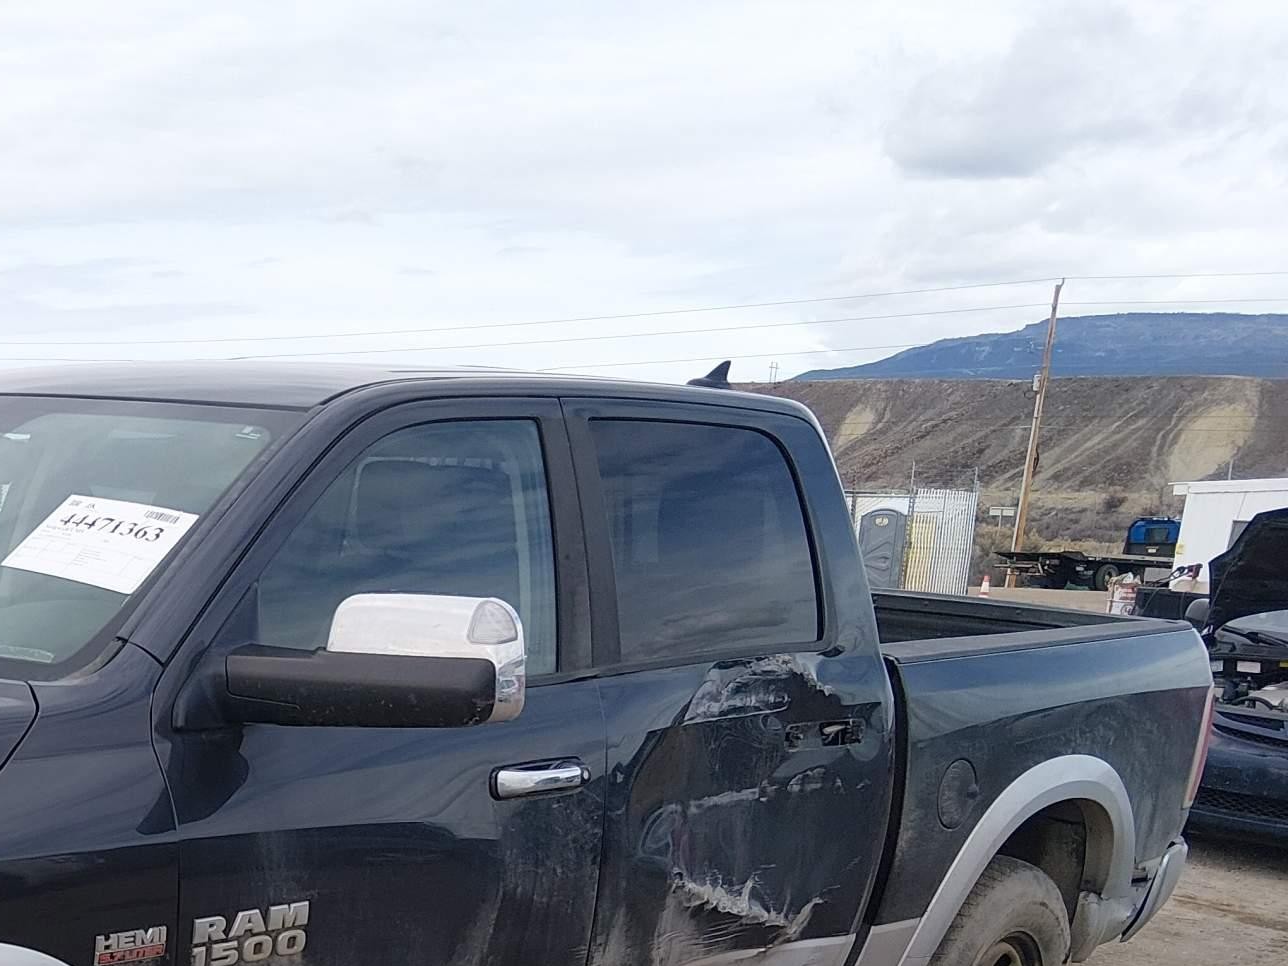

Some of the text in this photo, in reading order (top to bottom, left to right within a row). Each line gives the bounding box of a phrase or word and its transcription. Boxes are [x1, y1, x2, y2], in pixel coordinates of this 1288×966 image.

[60, 513, 165, 542] 44471363
[192, 900, 310, 944] RAM
[95, 925, 168, 953] HEMI
